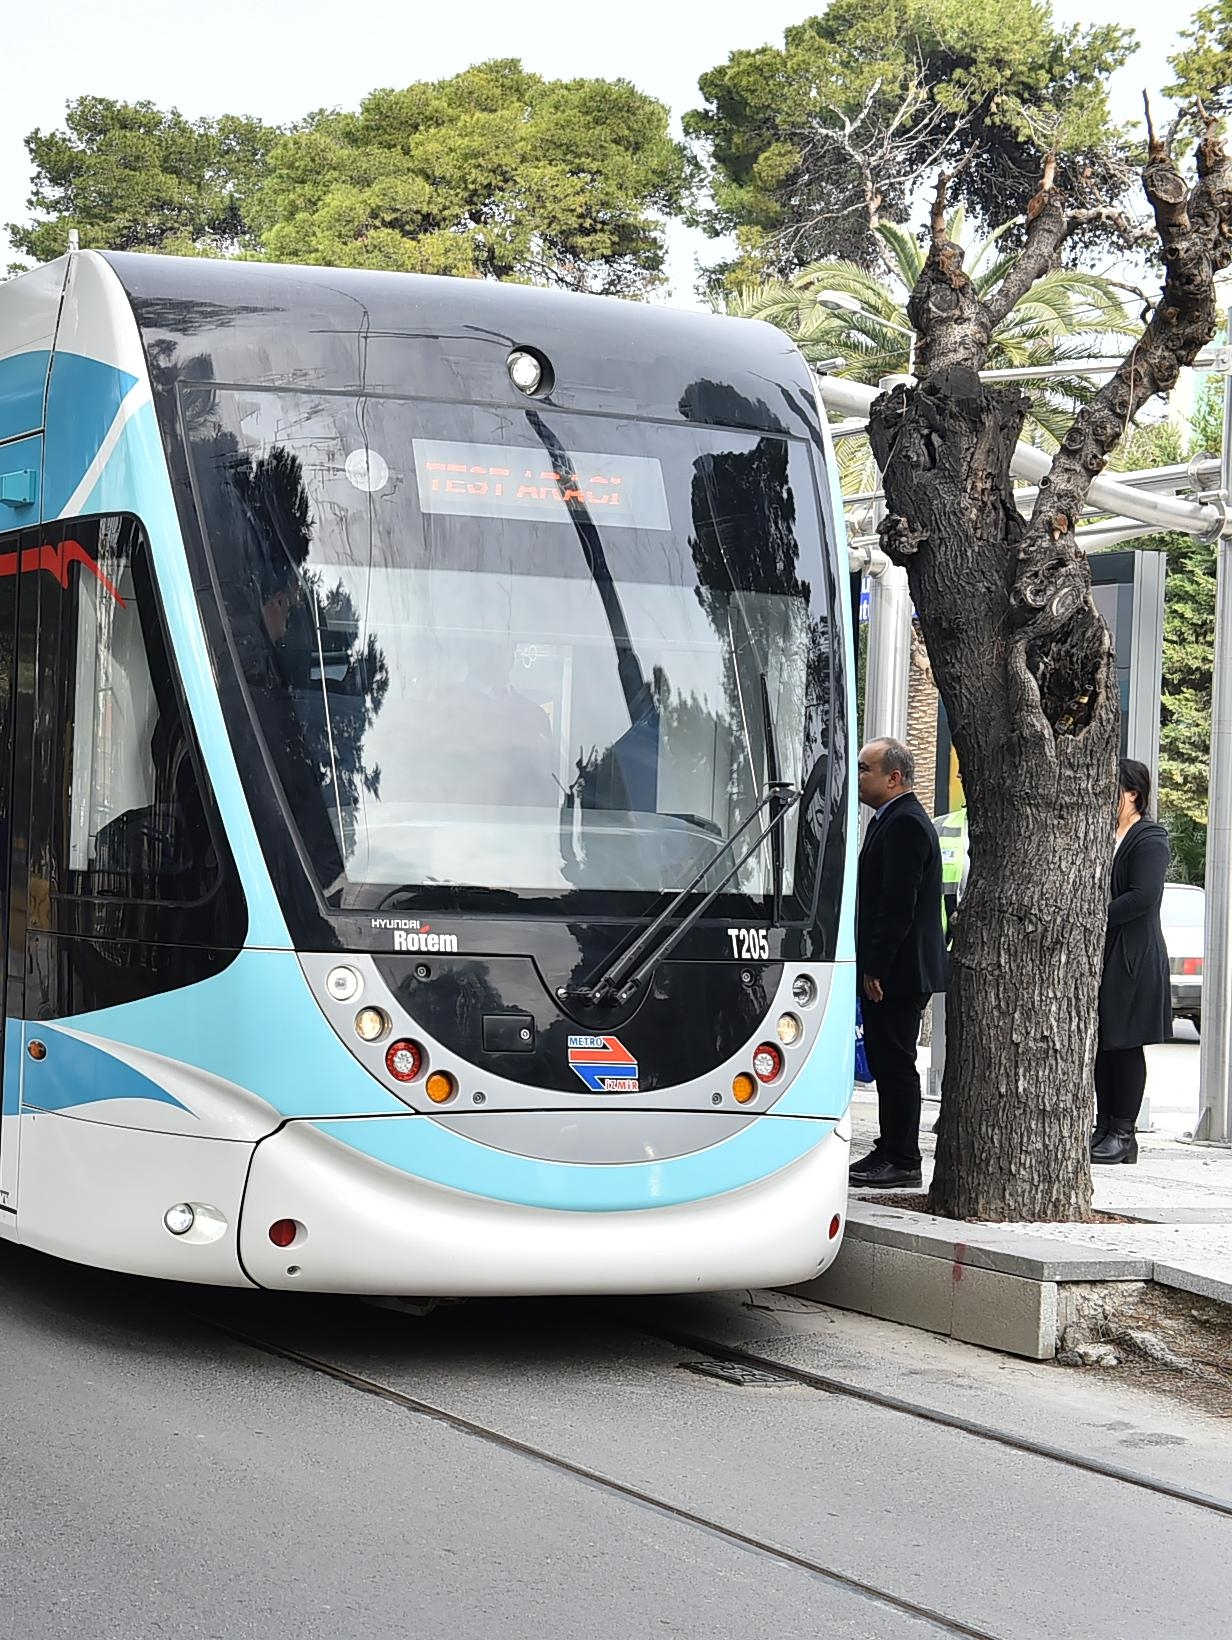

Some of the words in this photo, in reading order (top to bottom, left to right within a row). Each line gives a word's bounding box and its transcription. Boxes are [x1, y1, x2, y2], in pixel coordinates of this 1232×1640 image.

[426, 462, 510, 496] TEST
[371, 919, 421, 929] HYUNDAI
[393, 929, 458, 953] Rotem
[728, 929, 769, 960] T205
[568, 1036, 603, 1047] METRO
